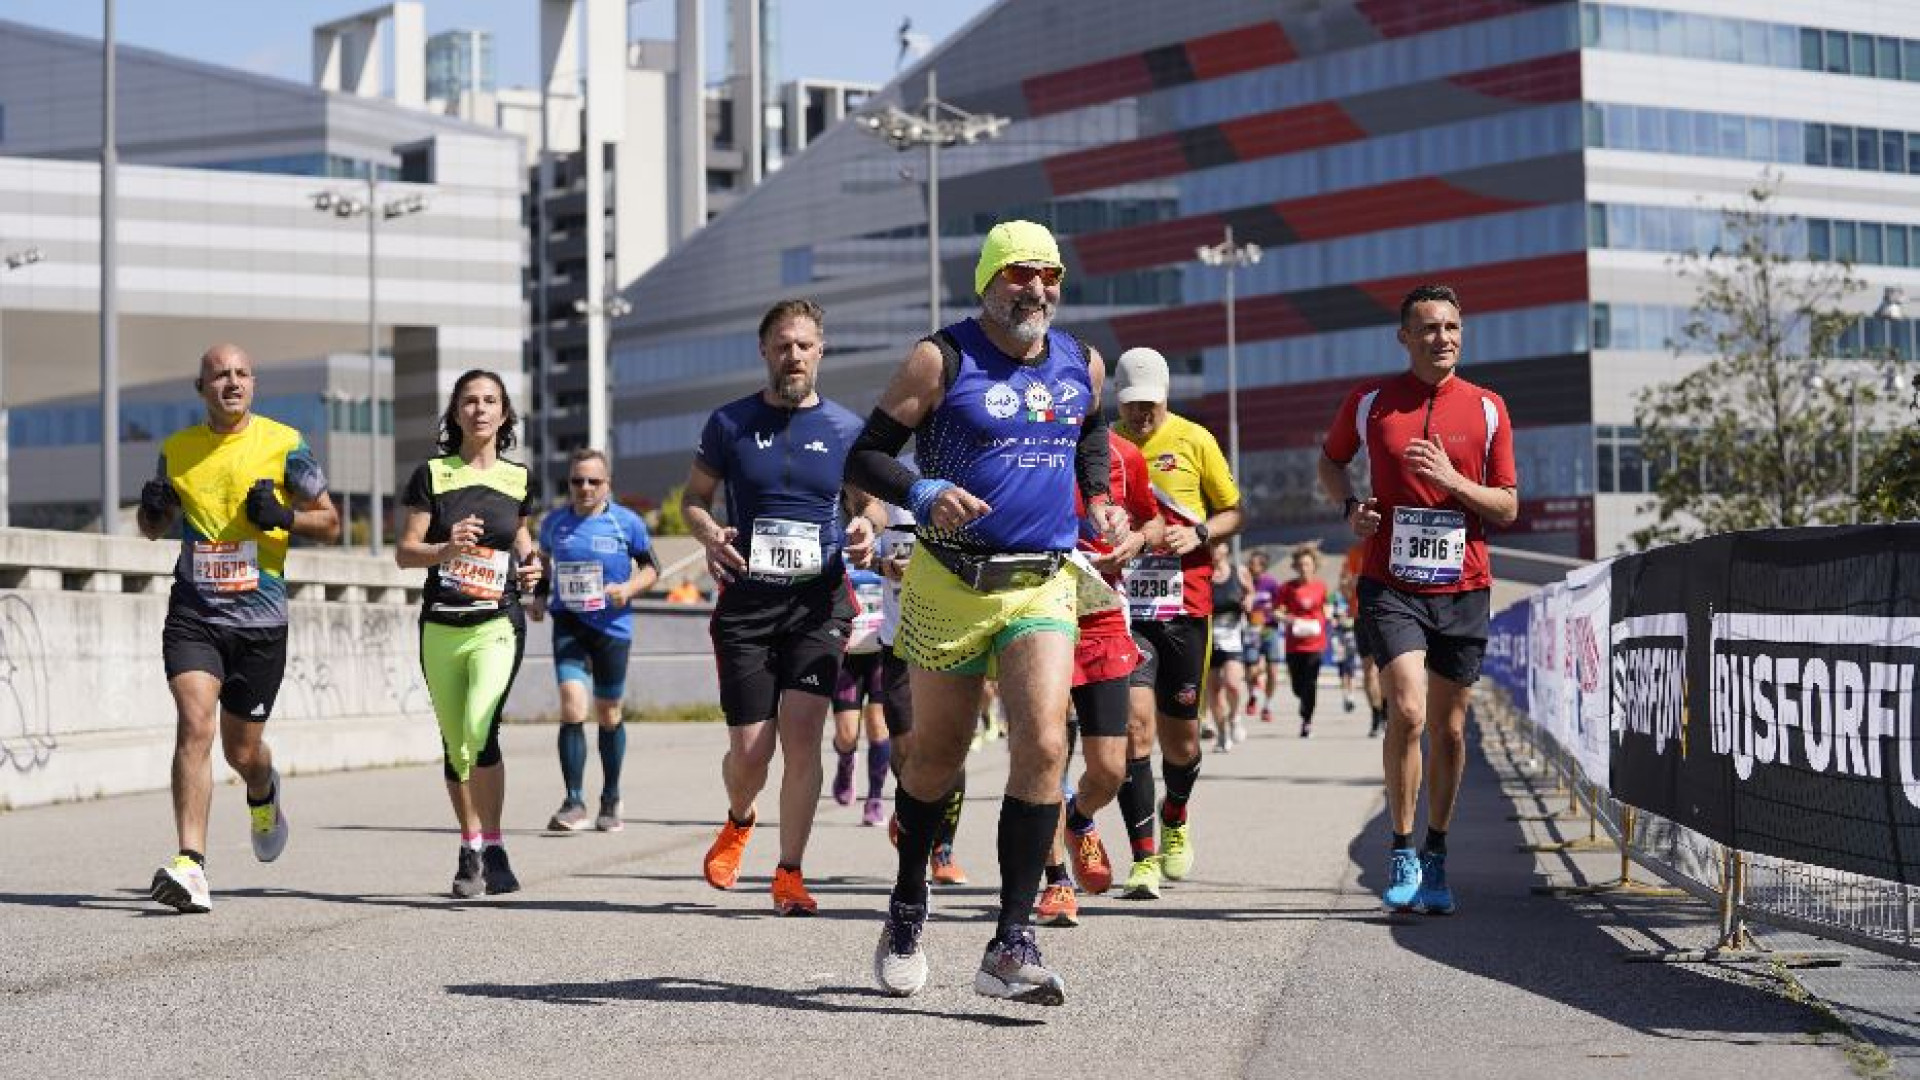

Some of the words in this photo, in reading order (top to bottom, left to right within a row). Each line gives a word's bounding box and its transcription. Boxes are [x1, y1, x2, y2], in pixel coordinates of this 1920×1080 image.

[770, 547, 803, 569] 1216
[1409, 536, 1449, 560] 3616
[1131, 579, 1168, 597] 9238
